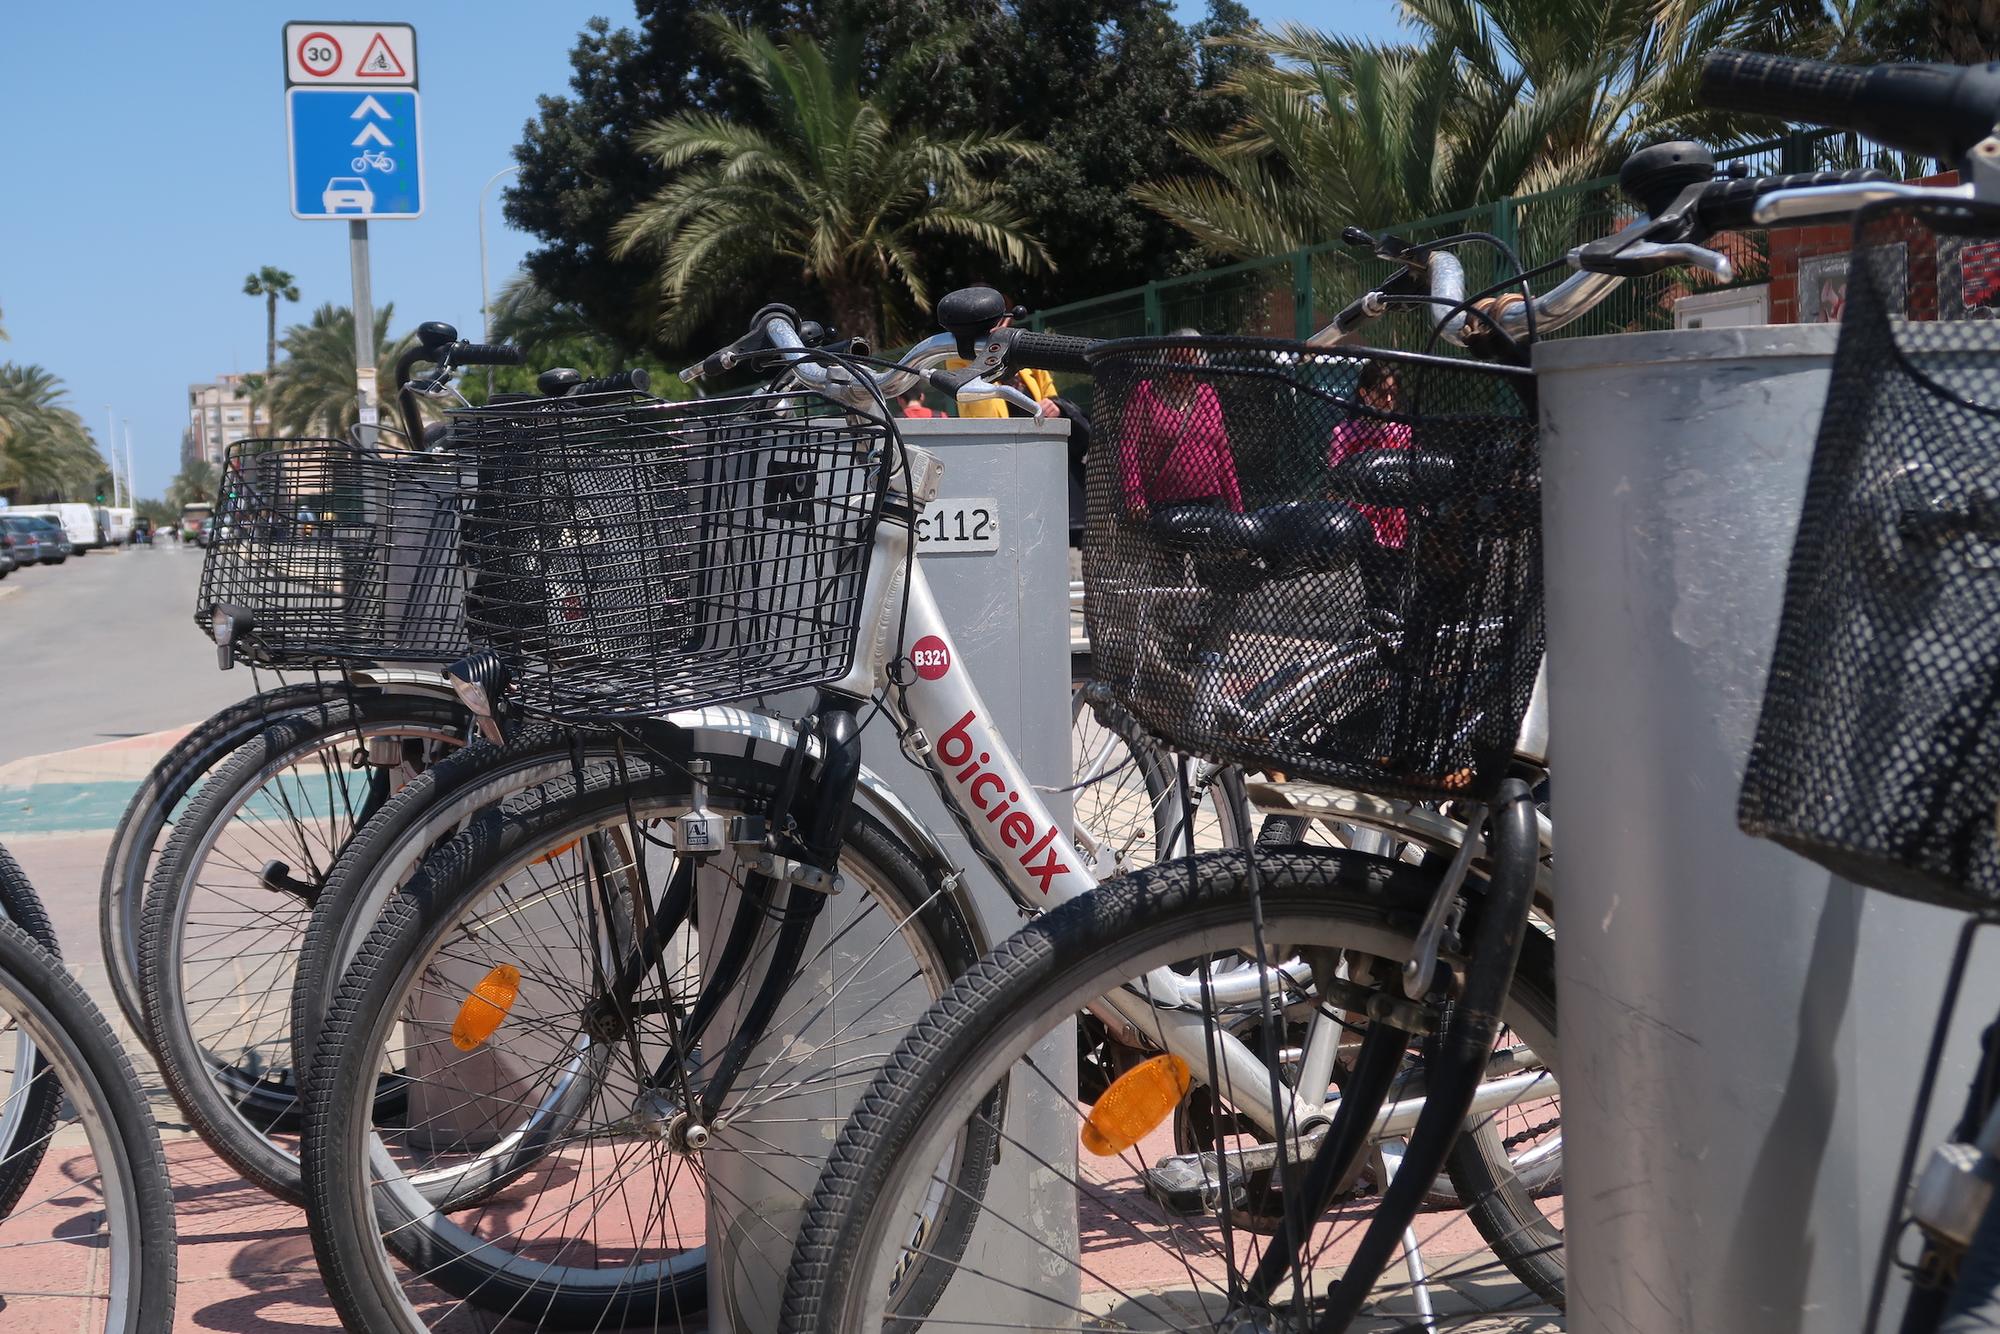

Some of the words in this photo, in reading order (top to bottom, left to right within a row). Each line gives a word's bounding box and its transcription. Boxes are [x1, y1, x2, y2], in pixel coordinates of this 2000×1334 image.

[307, 47, 332, 62] 30
[915, 649, 948, 667] B321
[936, 709, 1071, 896] bicielx
